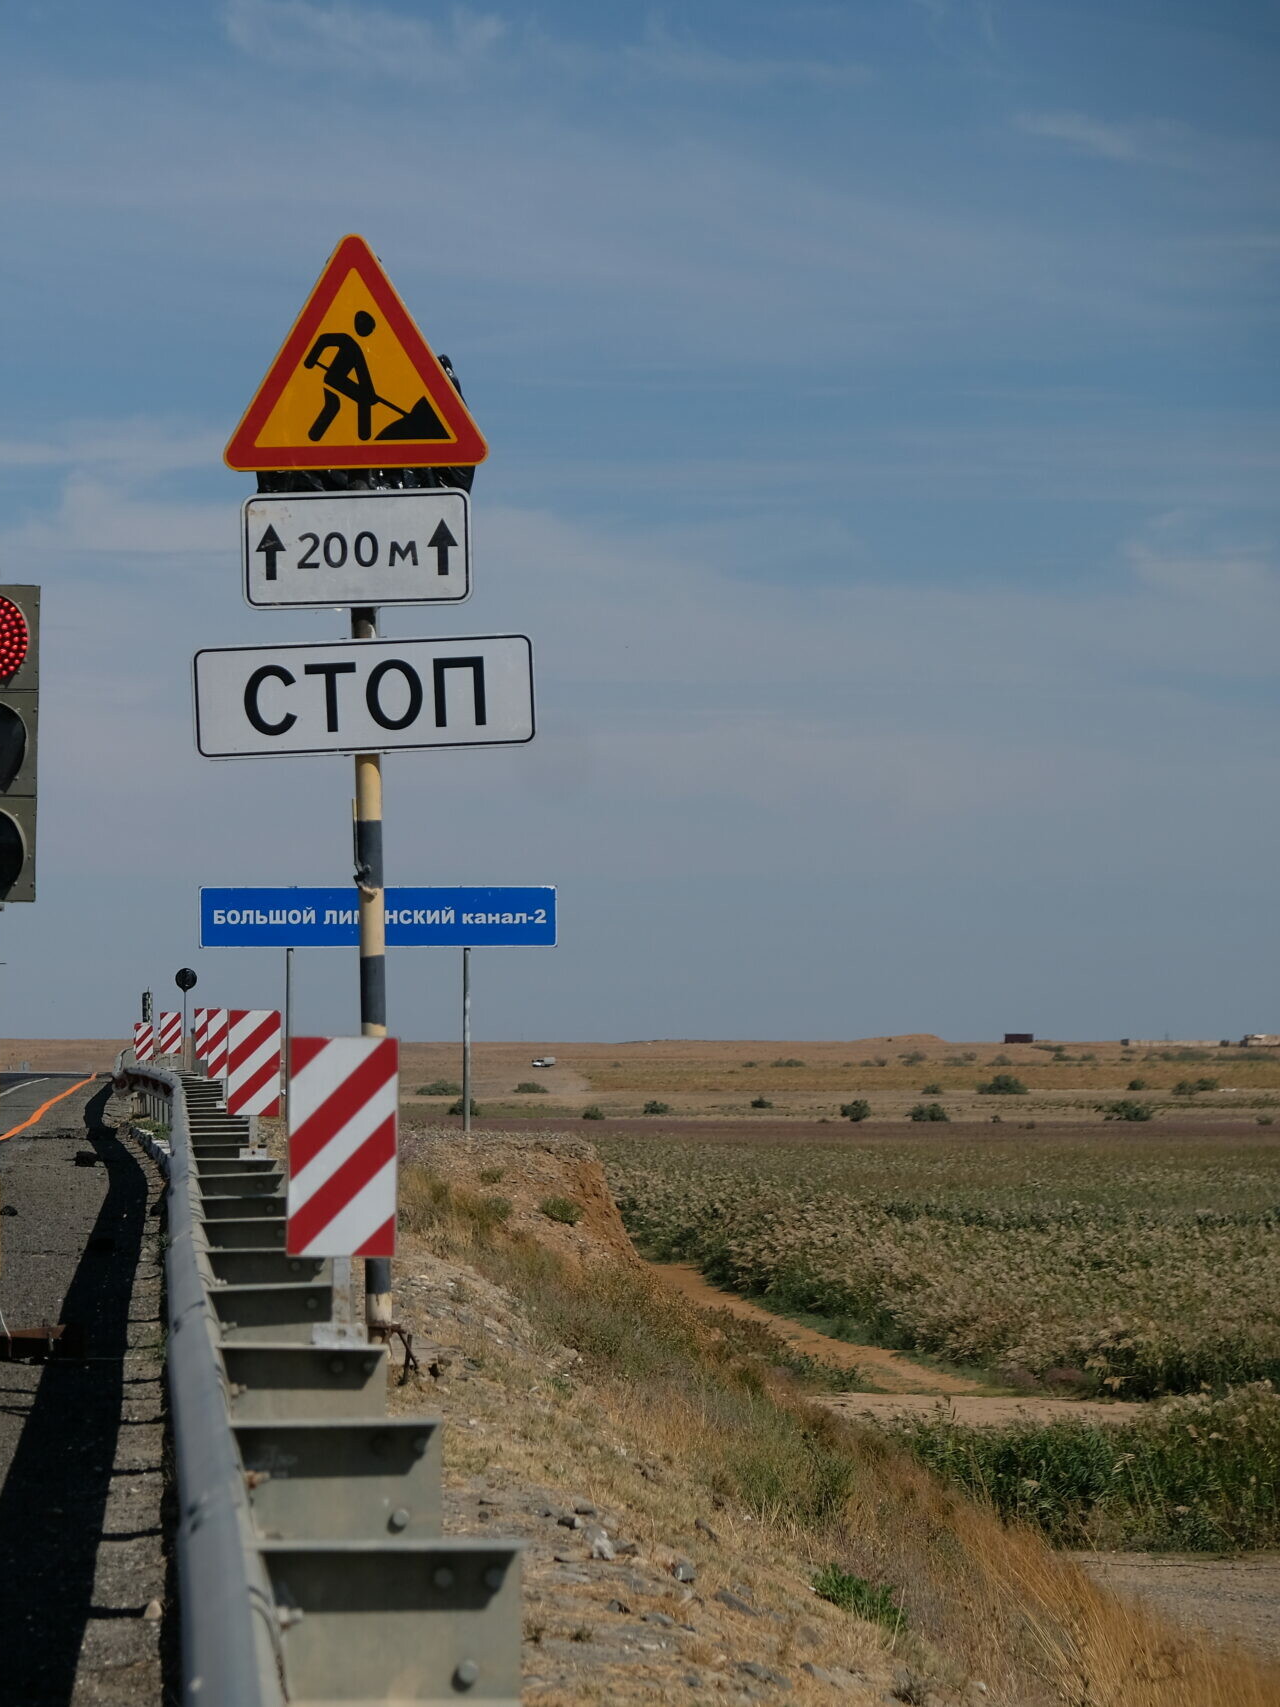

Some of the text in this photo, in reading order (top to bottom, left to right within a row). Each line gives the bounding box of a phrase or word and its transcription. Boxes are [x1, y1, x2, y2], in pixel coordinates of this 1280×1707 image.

[297, 530, 379, 569] 200
[243, 655, 487, 736] СТОП
[213, 906, 547, 925] БОЛЬШОЙ ЛИНСКИЙ канал-2
